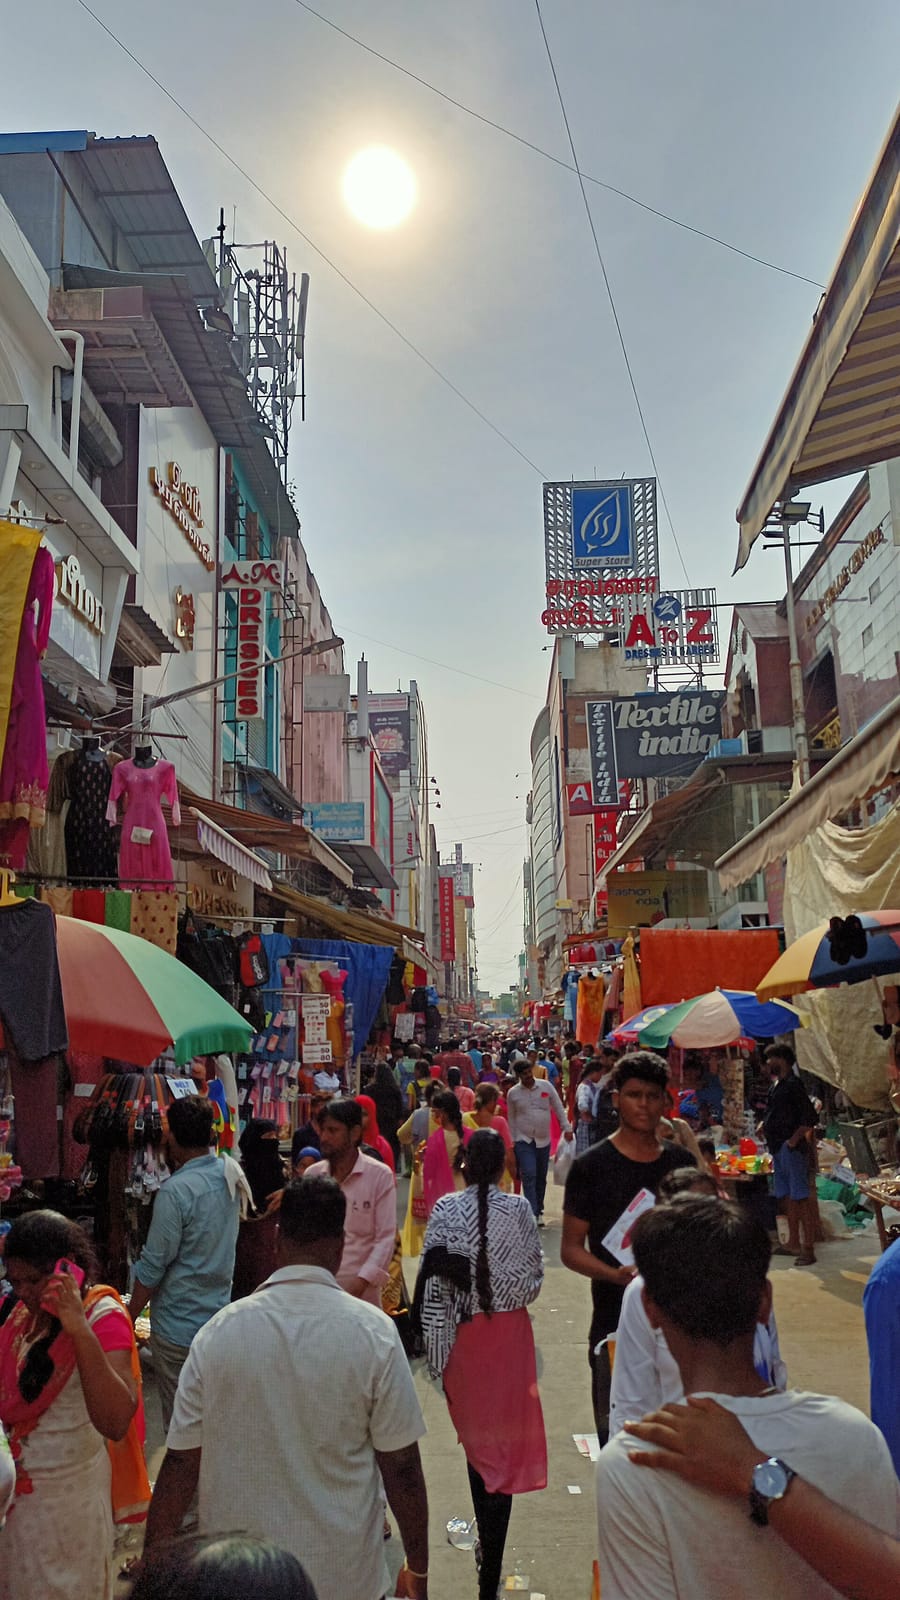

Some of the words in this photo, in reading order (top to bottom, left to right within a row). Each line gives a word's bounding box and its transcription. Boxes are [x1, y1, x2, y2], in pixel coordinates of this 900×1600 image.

[574, 558, 602, 568] Super
[604, 556, 630, 566] Store
[624, 614, 656, 647] A
[686, 609, 714, 644] Z
[238, 588, 262, 715] DRESSES
[614, 695, 717, 729] Textile
[638, 727, 719, 757] india
